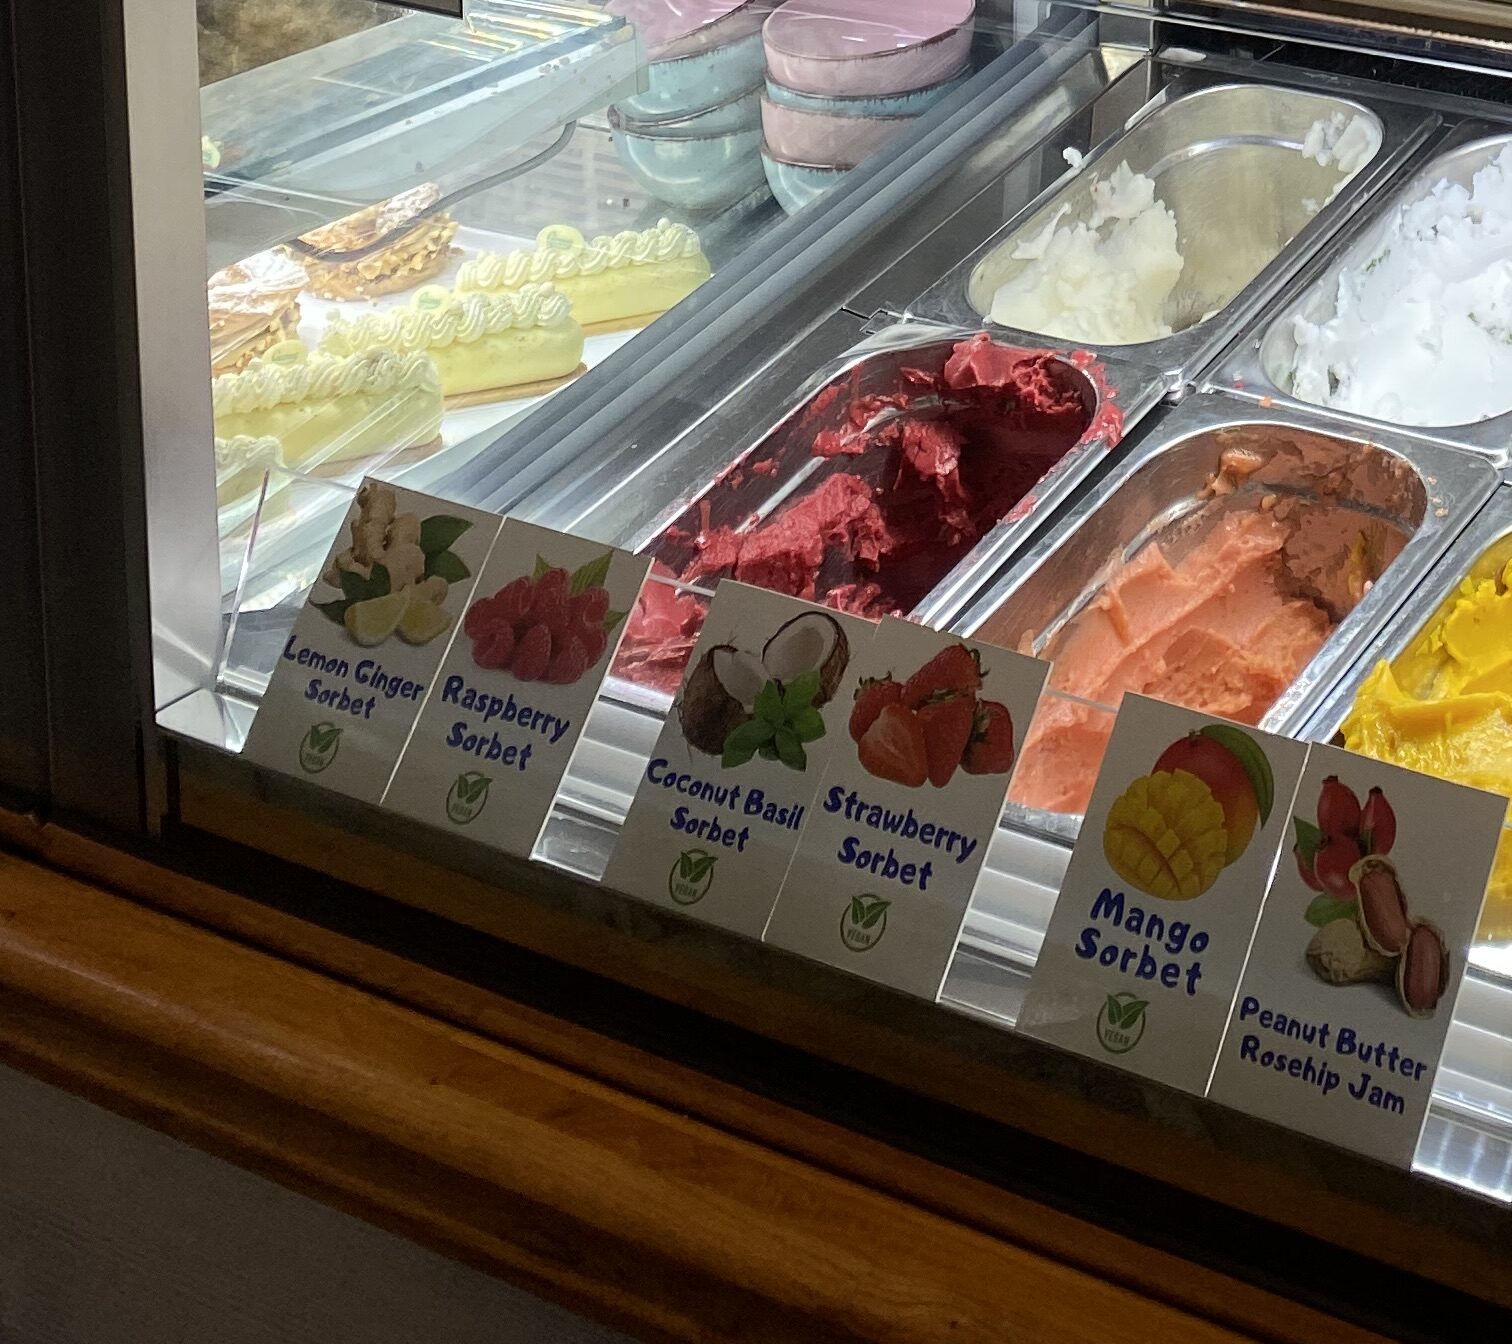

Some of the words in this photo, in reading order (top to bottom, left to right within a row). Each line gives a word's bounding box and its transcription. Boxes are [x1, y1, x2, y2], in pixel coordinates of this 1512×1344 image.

[283, 635, 348, 678] Lemon
[355, 659, 424, 701] Ginger
[305, 679, 375, 718] Sorbet
[443, 675, 570, 744] Raspberry
[447, 722, 532, 770] Sorbet
[647, 758, 740, 811] Coconut
[744, 789, 805, 830] Basil
[823, 786, 977, 863] Strawberry
[670, 806, 749, 852] Sorbet
[838, 837, 932, 890] Sorbet
[848, 927, 870, 945] VEGAN
[1090, 888, 1210, 954] Mango
[1075, 927, 1201, 996] Sorbet
[1104, 1029, 1130, 1046] VEGAN
[1239, 997, 1329, 1048] Peanut
[1336, 1028, 1427, 1081] Butter
[1240, 1035, 1340, 1095] Rosehip
[1348, 1072, 1406, 1115] Jam
